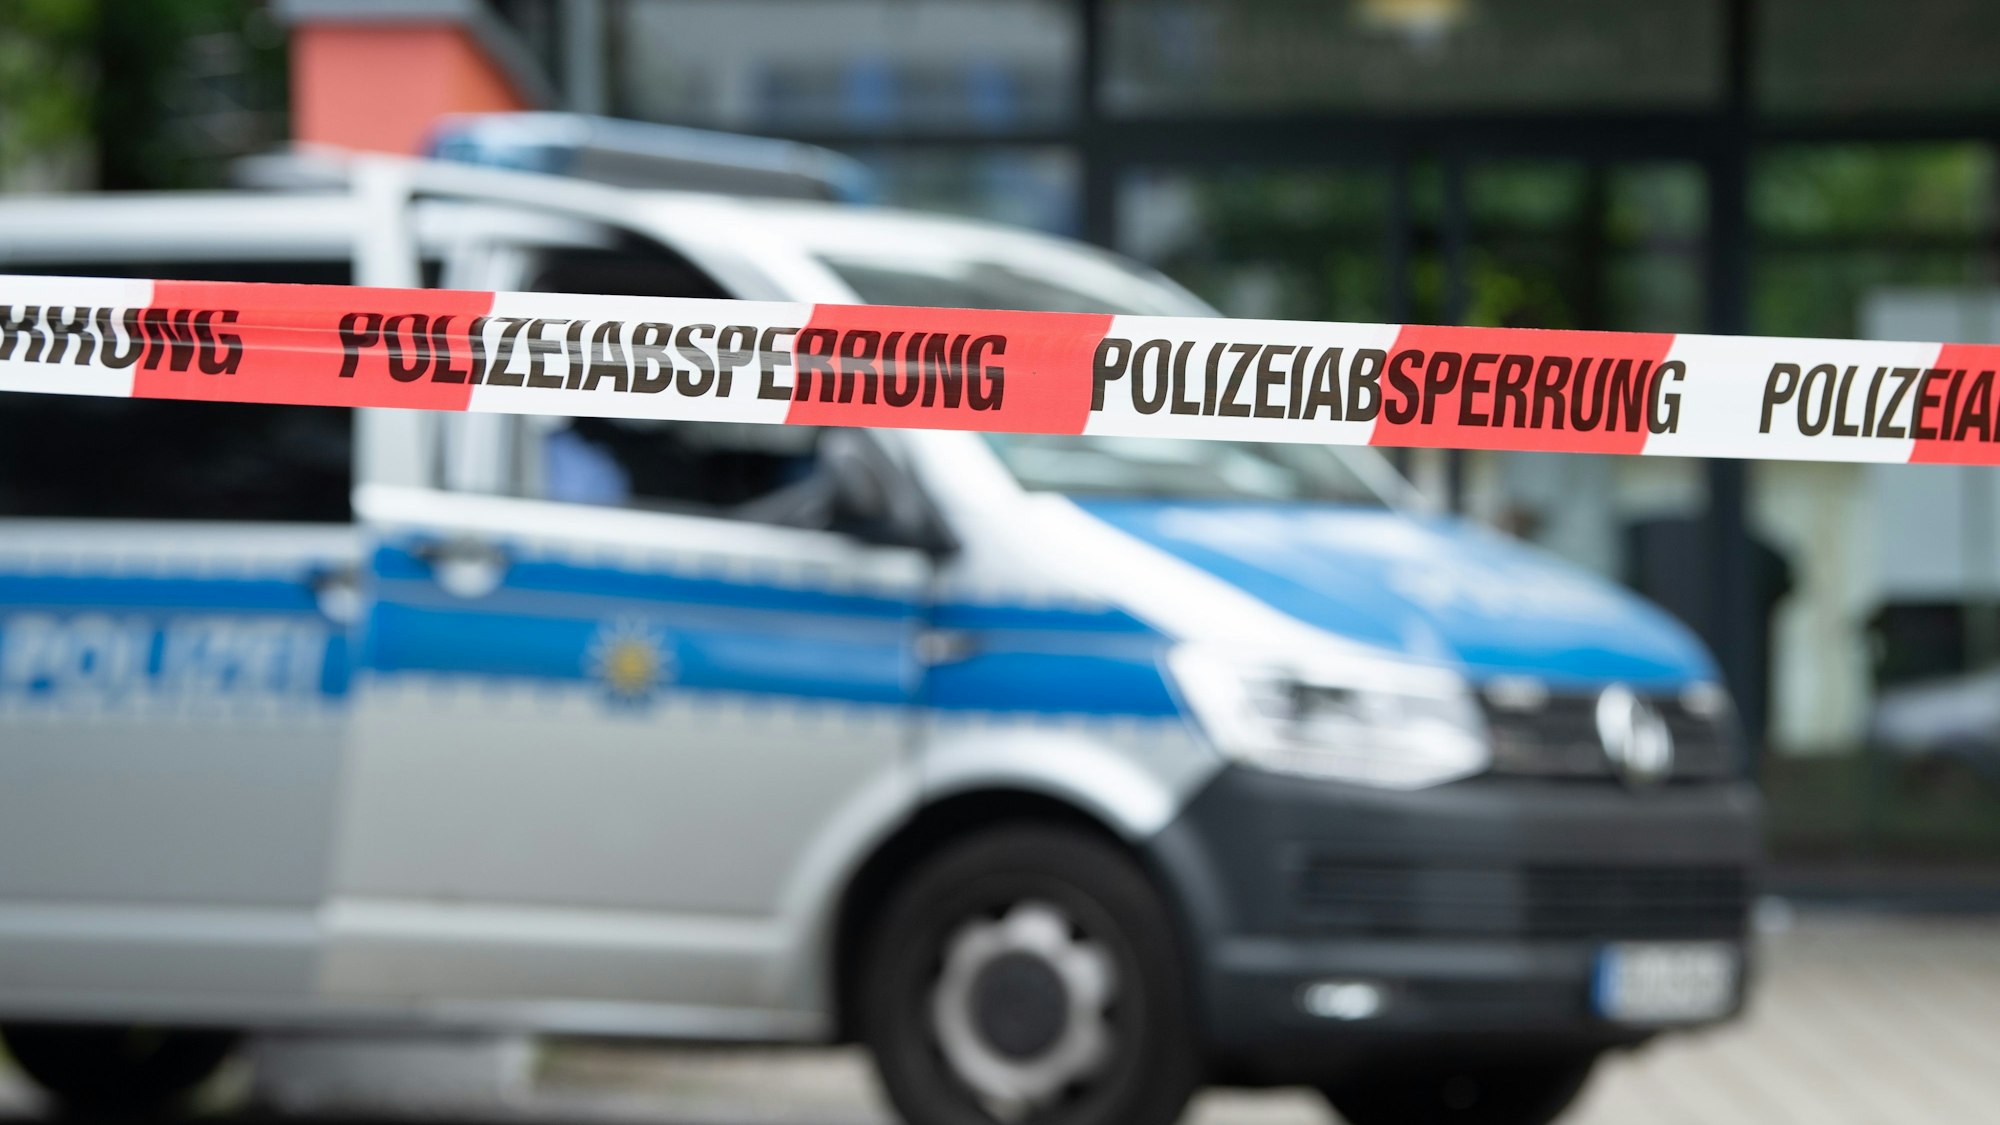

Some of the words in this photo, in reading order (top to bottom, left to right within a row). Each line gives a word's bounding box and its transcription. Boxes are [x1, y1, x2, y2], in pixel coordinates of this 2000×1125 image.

[338, 312, 1007, 412] POLIZEIABSPERRUNG
[1090, 337, 1686, 434] POLIZEIABSPERRUNG
[1758, 362, 2000, 443] POLIZEIA
